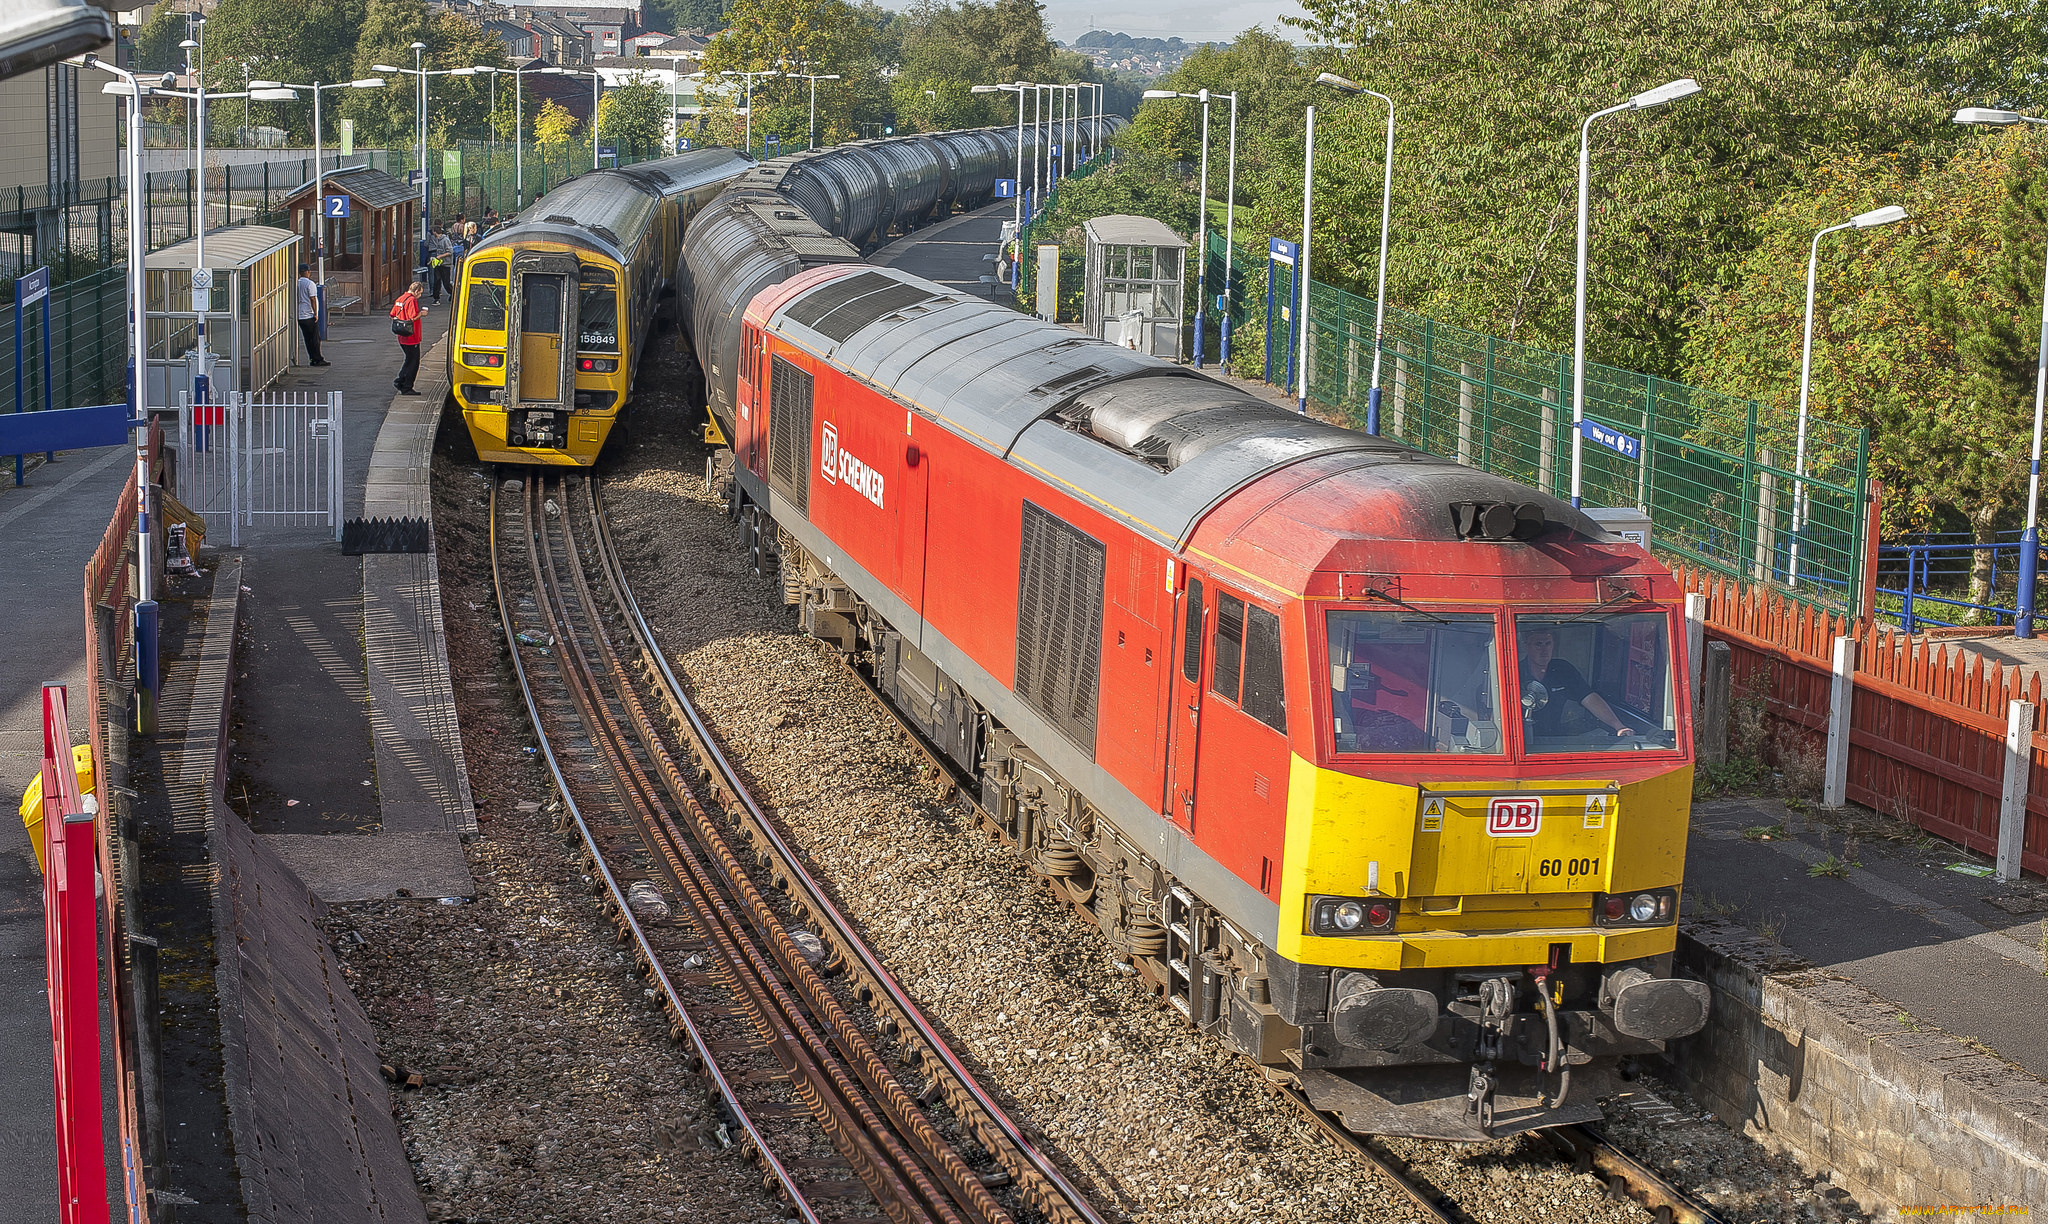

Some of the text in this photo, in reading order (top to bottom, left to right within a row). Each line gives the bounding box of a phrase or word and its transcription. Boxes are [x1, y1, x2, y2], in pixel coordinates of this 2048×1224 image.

[681, 139, 688, 149] 2
[1051, 145, 1057, 155] 1
[1000, 181, 1008, 195] 1
[331, 198, 344, 215] 2
[580, 334, 615, 344] 158849
[1592, 426, 1615, 446] Way out
[823, 426, 837, 479] DB
[838, 447, 884, 510] SCHENKER
[1495, 803, 1534, 829] DB
[1540, 857, 1600, 876] 60 001
